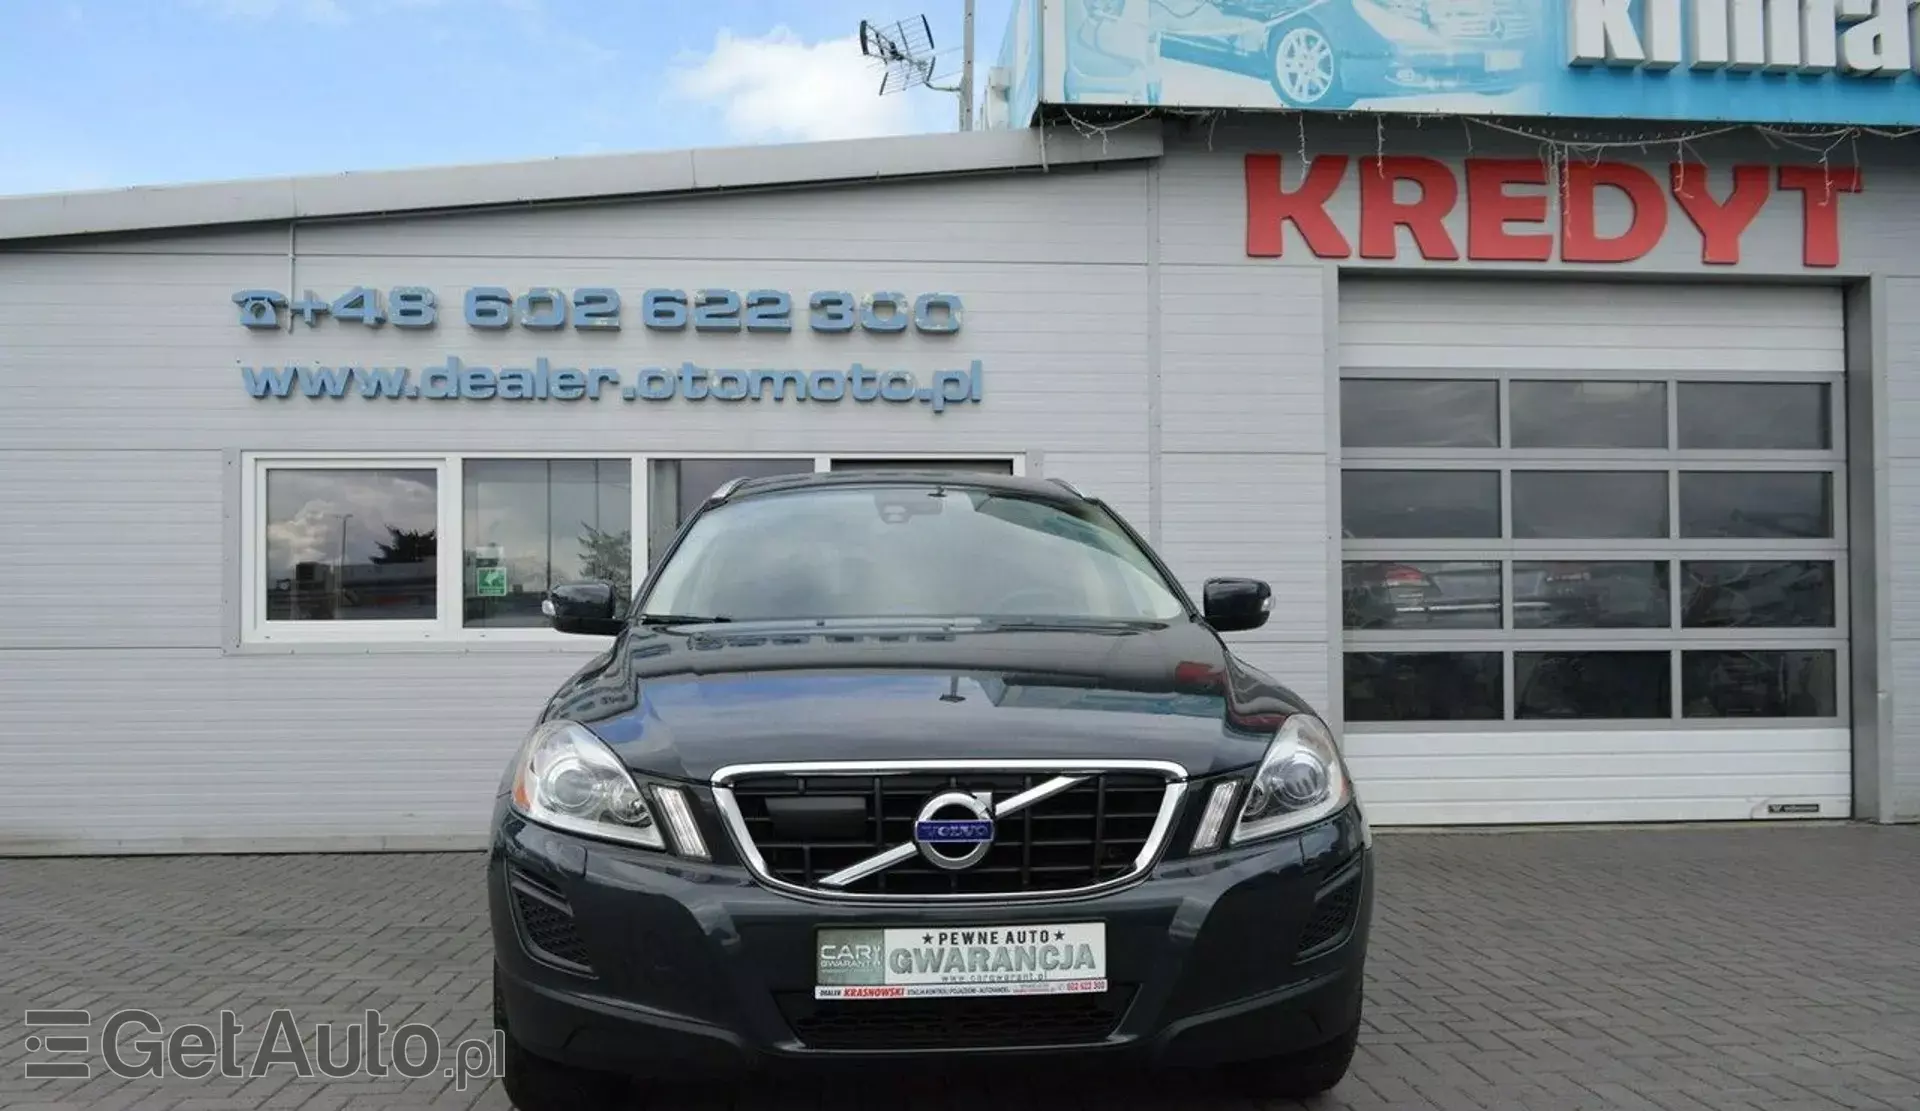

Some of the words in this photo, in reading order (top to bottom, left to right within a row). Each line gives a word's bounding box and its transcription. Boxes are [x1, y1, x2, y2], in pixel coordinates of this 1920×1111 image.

[1244, 153, 1863, 267] KREDYT
[290, 286, 437, 329] +48
[464, 286, 620, 332] 602
[642, 288, 792, 333] 622
[809, 290, 964, 335] 300
[240, 356, 982, 414] www.dealer.otomoto.pl
[820, 945, 872, 960] CAR
[939, 931, 999, 946] PEWNE
[1005, 930, 1050, 945] AUTO
[889, 943, 1097, 975] GWARANCJA
[843, 987, 904, 997] KRASNOWSKI
